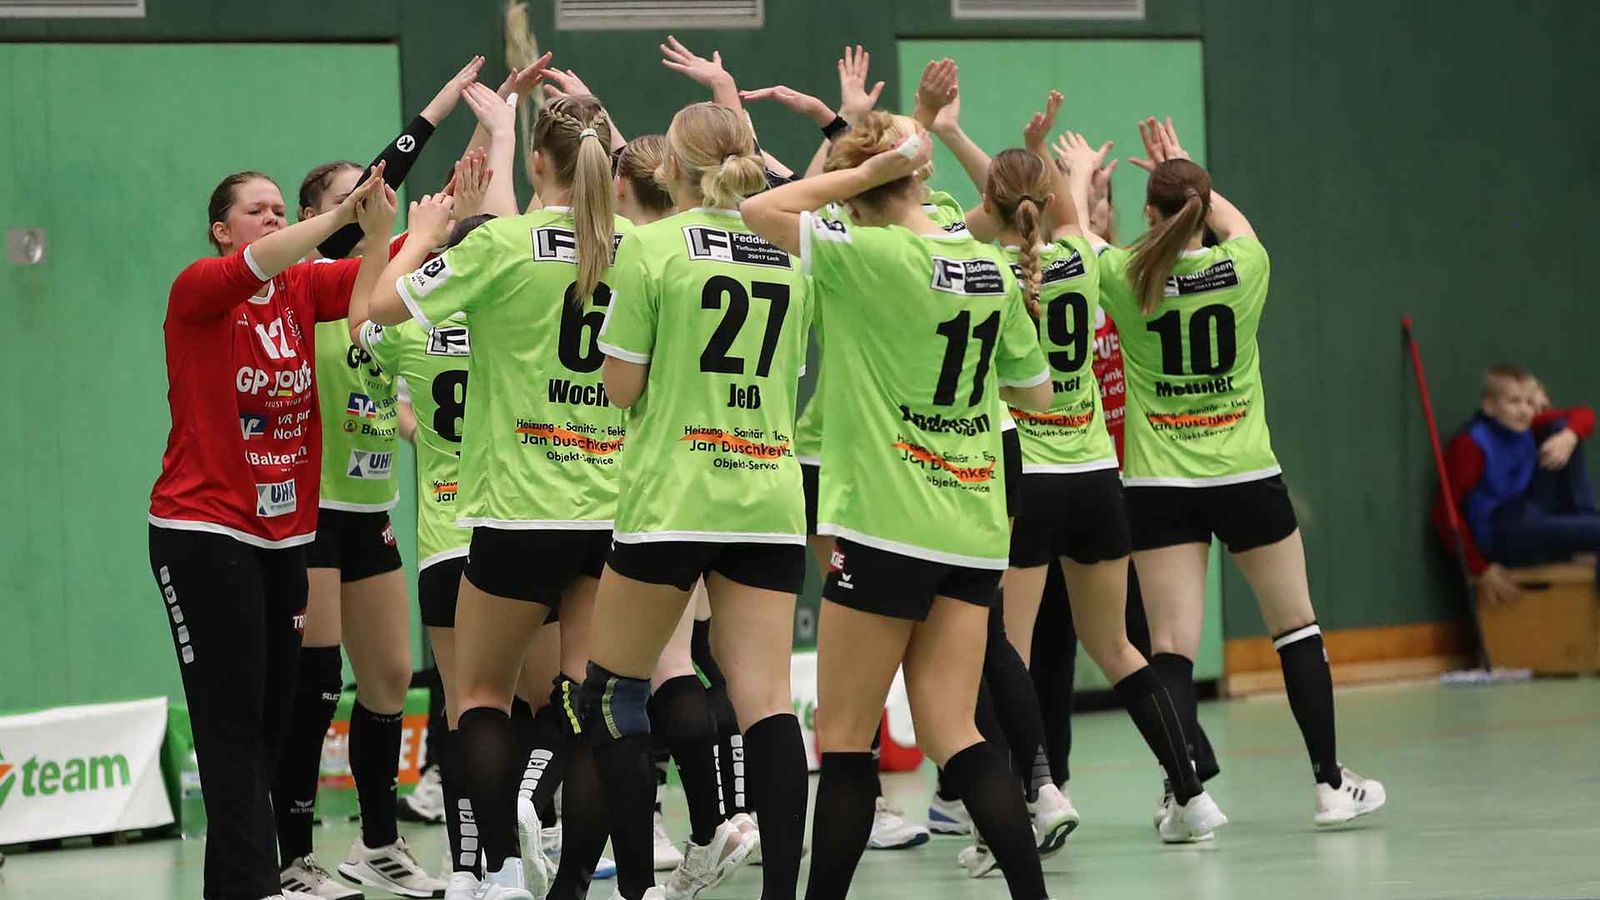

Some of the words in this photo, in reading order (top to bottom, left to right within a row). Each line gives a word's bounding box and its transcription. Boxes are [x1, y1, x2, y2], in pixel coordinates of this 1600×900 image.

[733, 233, 770, 245] Fedde
[255, 317, 297, 359] 12
[558, 280, 613, 374] 6
[700, 275, 791, 378] 27
[1036, 292, 1089, 373] 9
[1146, 303, 1237, 377] 10
[932, 310, 1001, 408] 11
[236, 366, 270, 395] GP
[1102, 368, 1123, 382] ank
[431, 369, 469, 443] 8
[548, 378, 610, 408] Woch
[727, 383, 762, 410] Jeß
[278, 413, 293, 426] VR
[380, 408, 397, 421] ord
[516, 419, 555, 433] Heizung
[521, 433, 548, 446] Jan
[684, 425, 723, 438] Heizung
[689, 440, 716, 452] Jan
[21, 754, 132, 797] team
